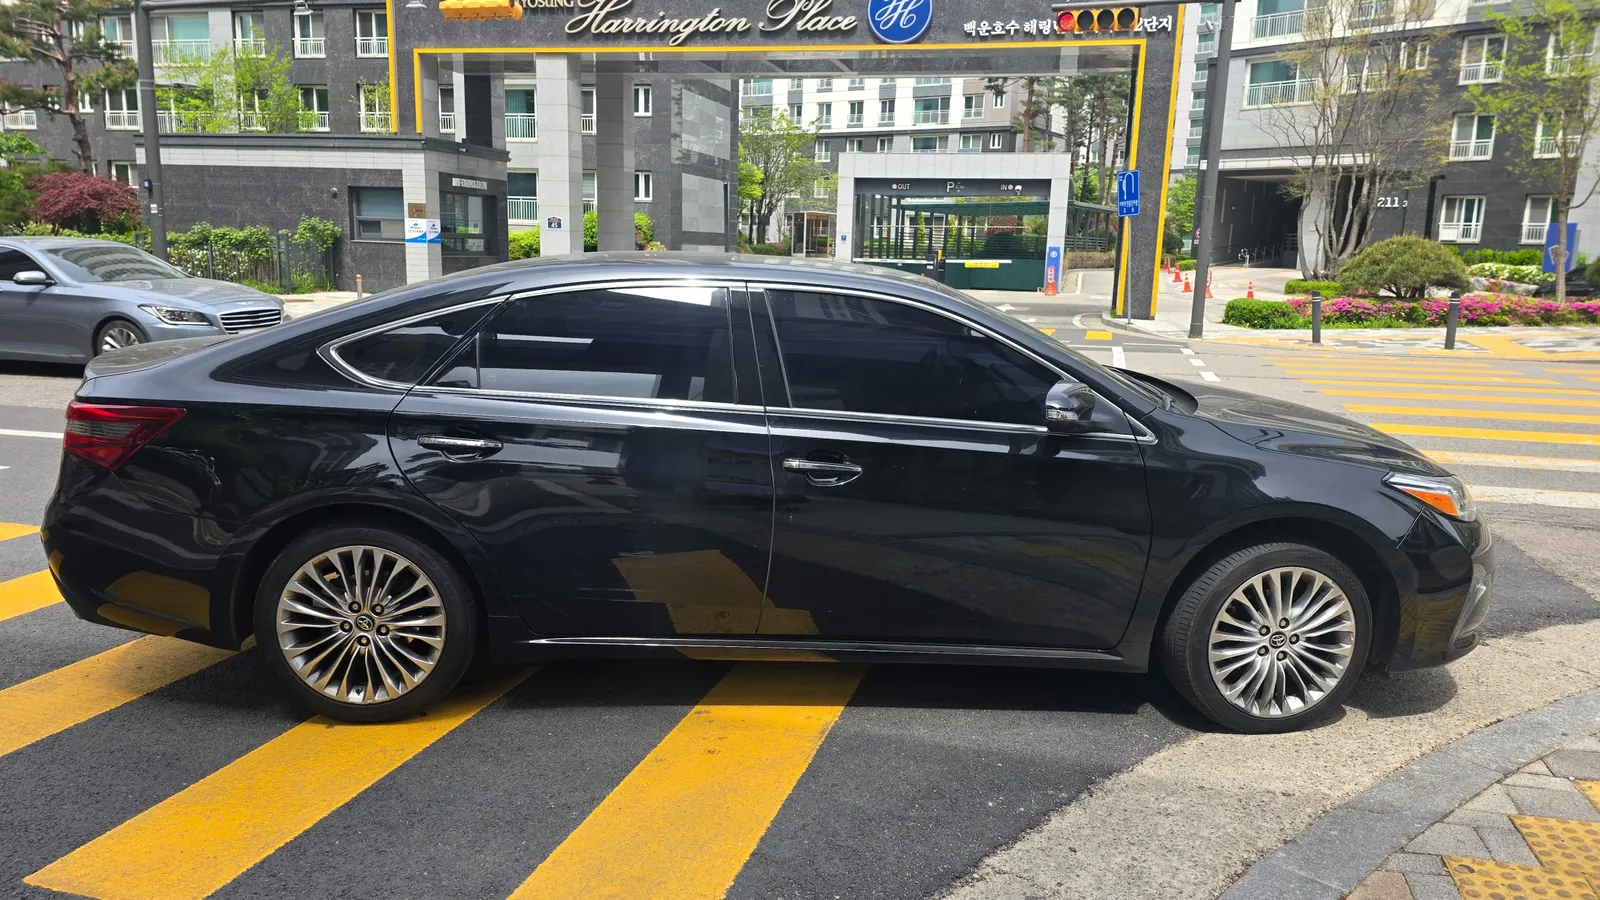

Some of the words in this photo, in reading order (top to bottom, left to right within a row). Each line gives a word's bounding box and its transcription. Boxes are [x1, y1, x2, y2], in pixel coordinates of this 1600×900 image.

[564, 0, 751, 47] Harrington
[758, 0, 858, 32] Place
[963, 20, 1020, 36] 백운호수
[946, 181, 955, 193] P
[1377, 196, 1399, 207] 211
[1402, 200, 1409, 208] 3
